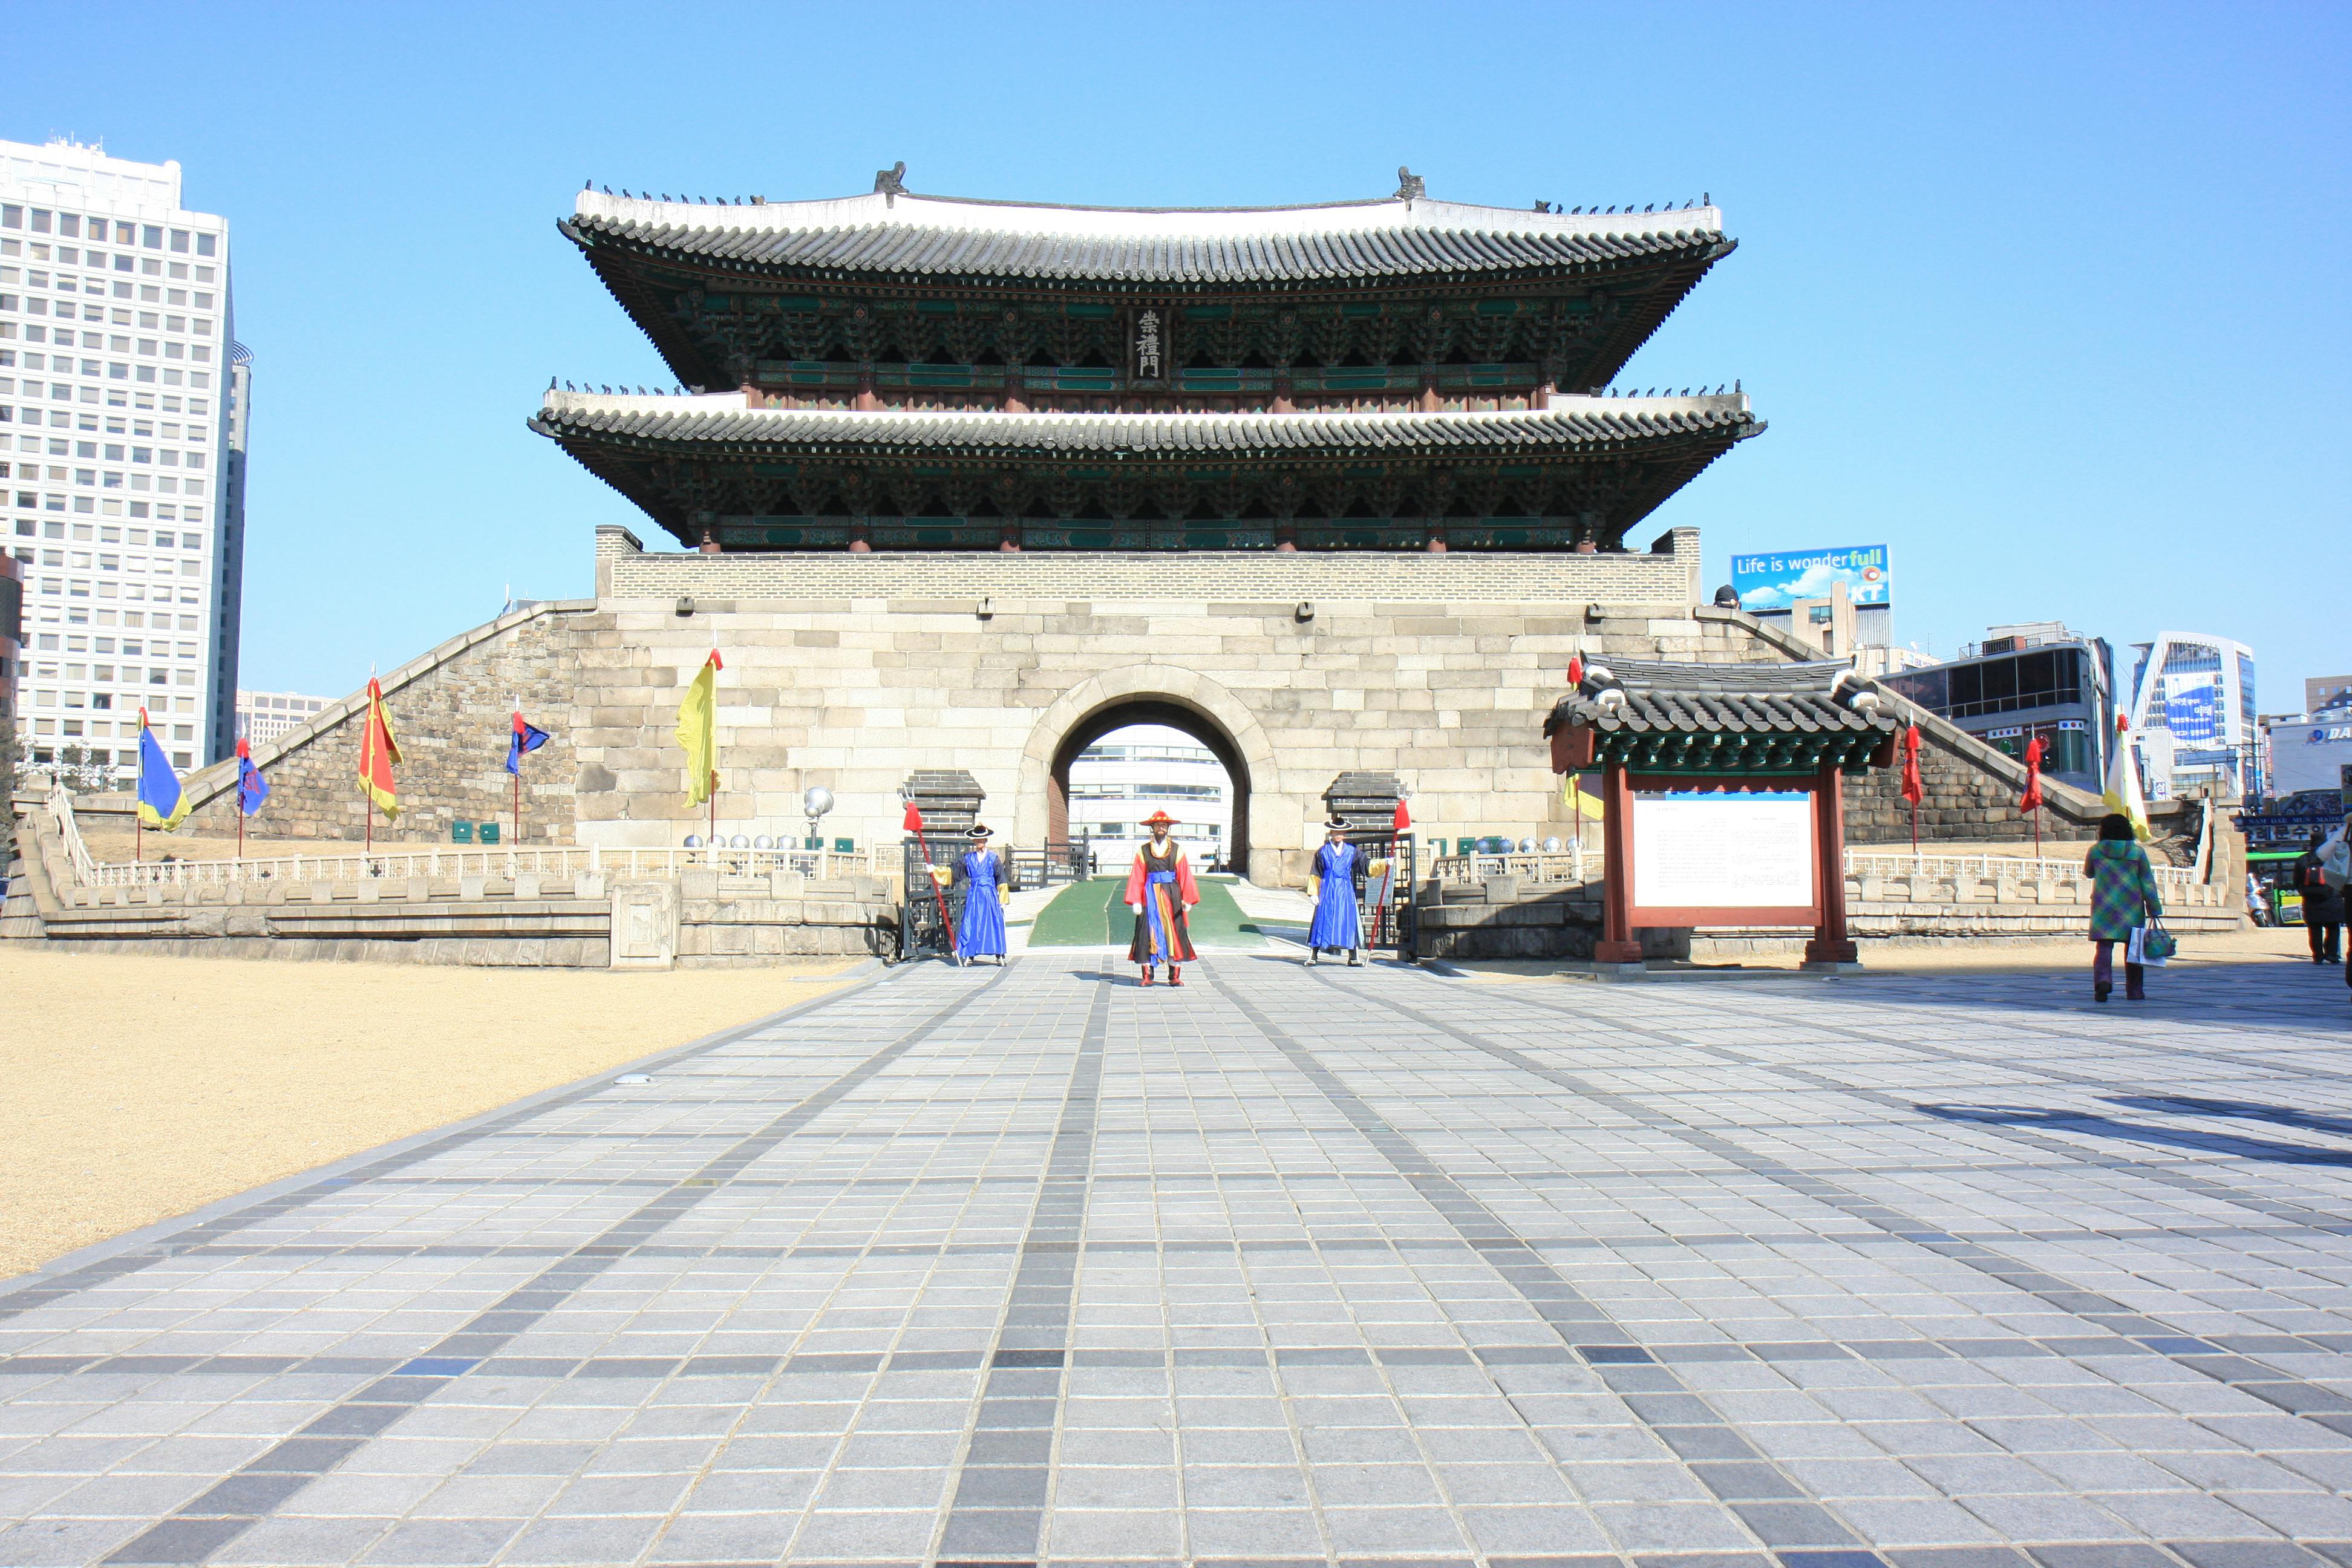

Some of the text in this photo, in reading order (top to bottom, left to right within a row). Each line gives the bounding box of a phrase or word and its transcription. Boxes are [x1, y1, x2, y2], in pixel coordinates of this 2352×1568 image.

[1135, 309, 1161, 378] 崇禮門
[1737, 557, 1766, 574] Life
[1771, 556, 1783, 572] is
[1851, 584, 1883, 603] KT
[2194, 704, 2212, 717] 미래
[2327, 727, 2352, 740] DA
